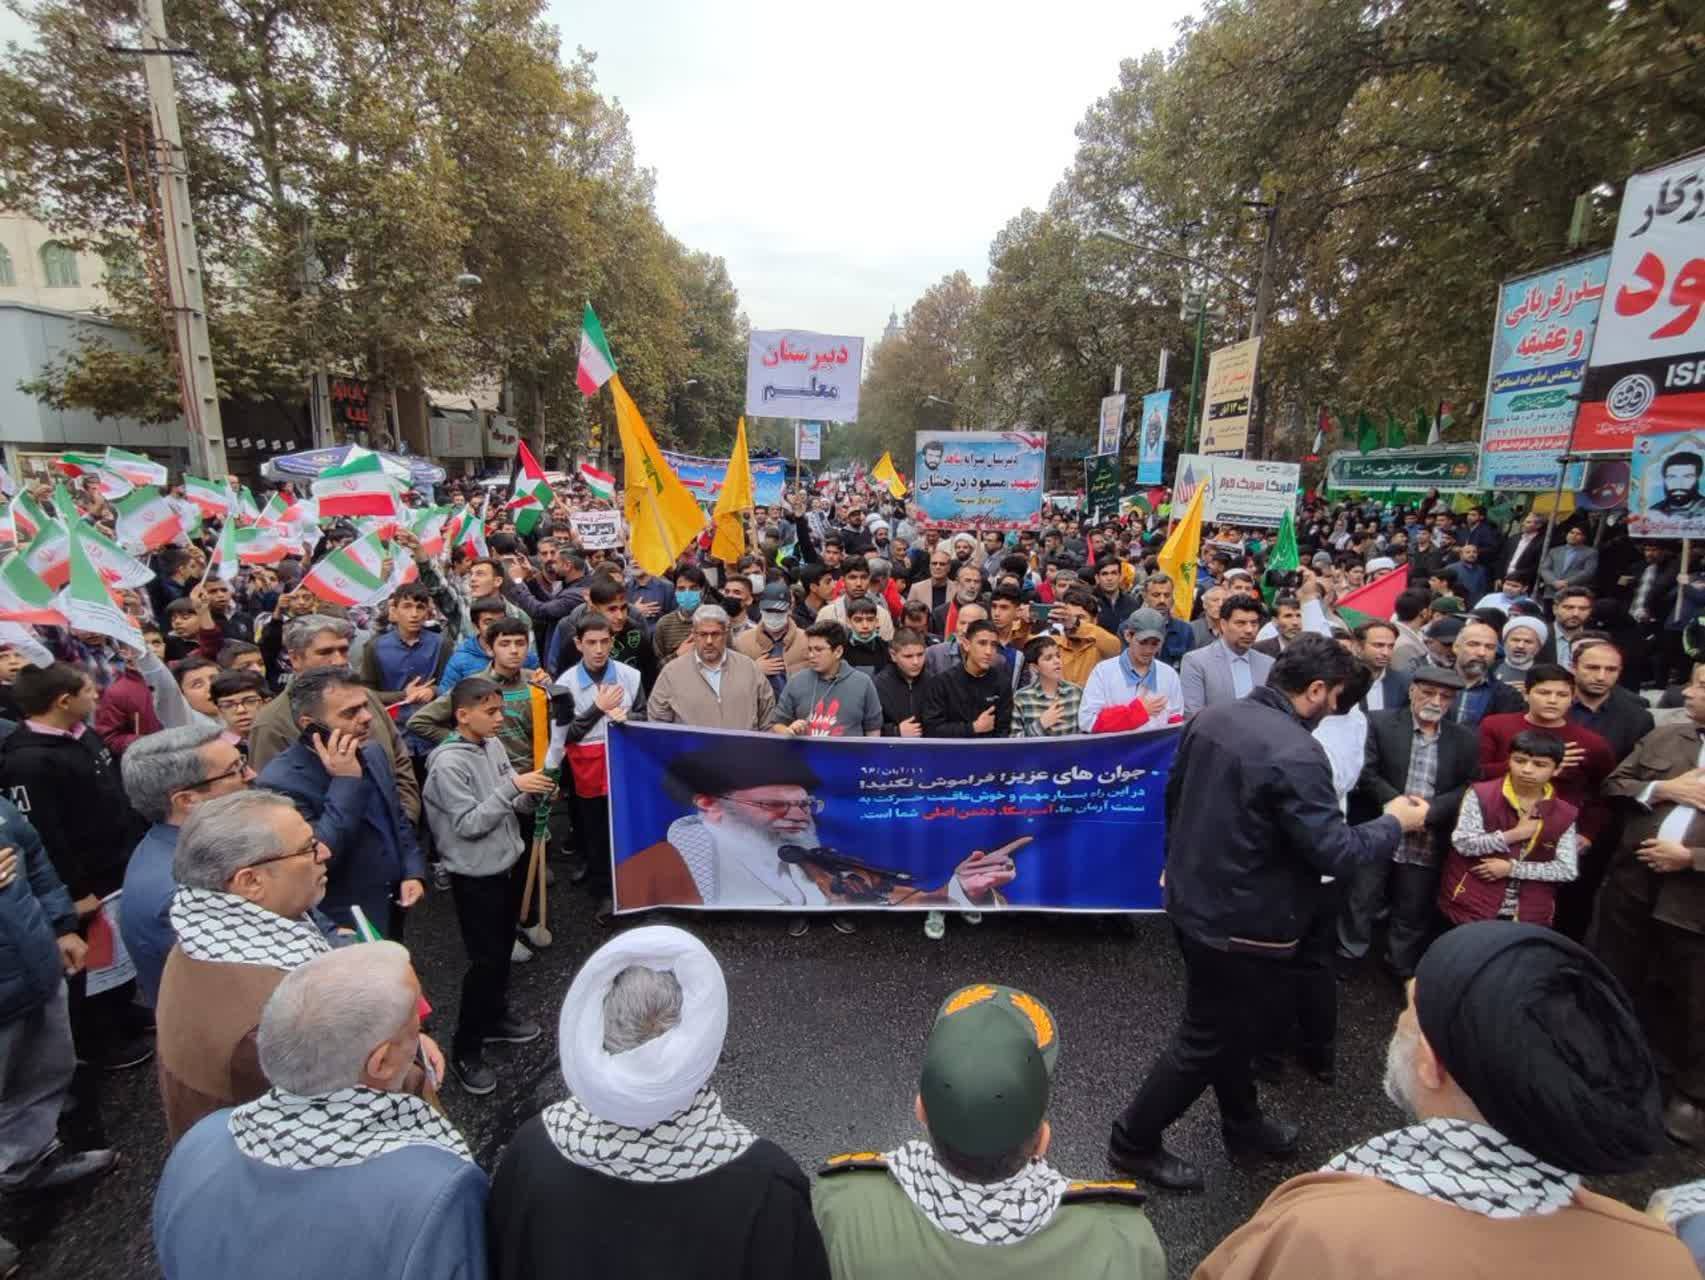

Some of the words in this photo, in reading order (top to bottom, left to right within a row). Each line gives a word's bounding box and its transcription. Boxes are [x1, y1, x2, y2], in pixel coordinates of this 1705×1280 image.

[762, 339, 849, 372] دبیرستان
[1052, 765, 1093, 785] های
[1097, 764, 1146, 784] جوان
[918, 772, 996, 790] فراموش
[1008, 793, 1017, 803] و
[1020, 793, 1050, 804] مهم
[1051, 789, 1088, 802] بسیار
[1089, 788, 1105, 799] راه
[895, 808, 919, 818] شما
[1110, 801, 1145, 812] سمت
[922, 806, 956, 821] اصلی
